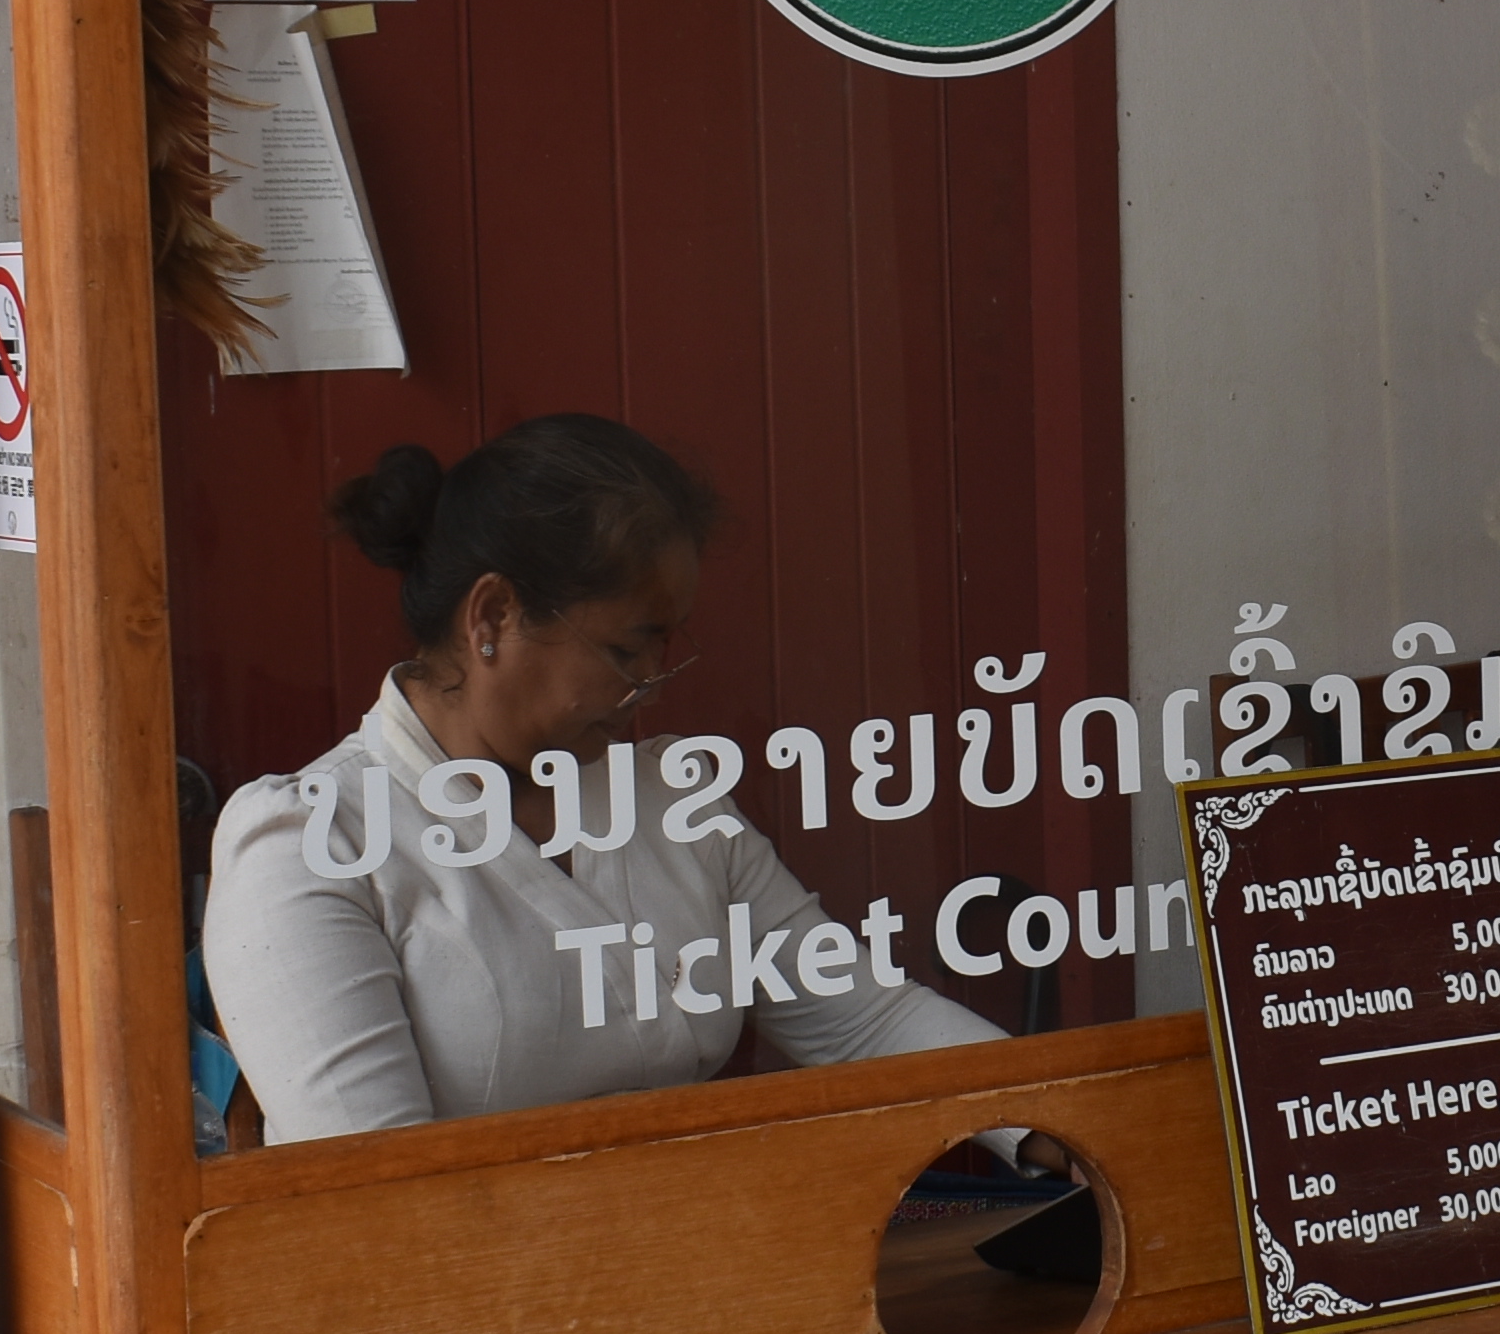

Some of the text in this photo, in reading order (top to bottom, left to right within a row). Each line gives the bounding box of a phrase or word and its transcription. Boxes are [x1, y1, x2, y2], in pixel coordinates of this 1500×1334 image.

[555, 876, 1195, 1028] Ticket Coun
[1253, 942, 1336, 978] ຄົນລາວ
[1261, 987, 1414, 1029] ຄົນຕ່າງປະເທດ
[1278, 1088, 1400, 1140] Ticket
[1288, 1173, 1336, 1201] Lao
[1294, 1201, 1420, 1247] Foreigner
